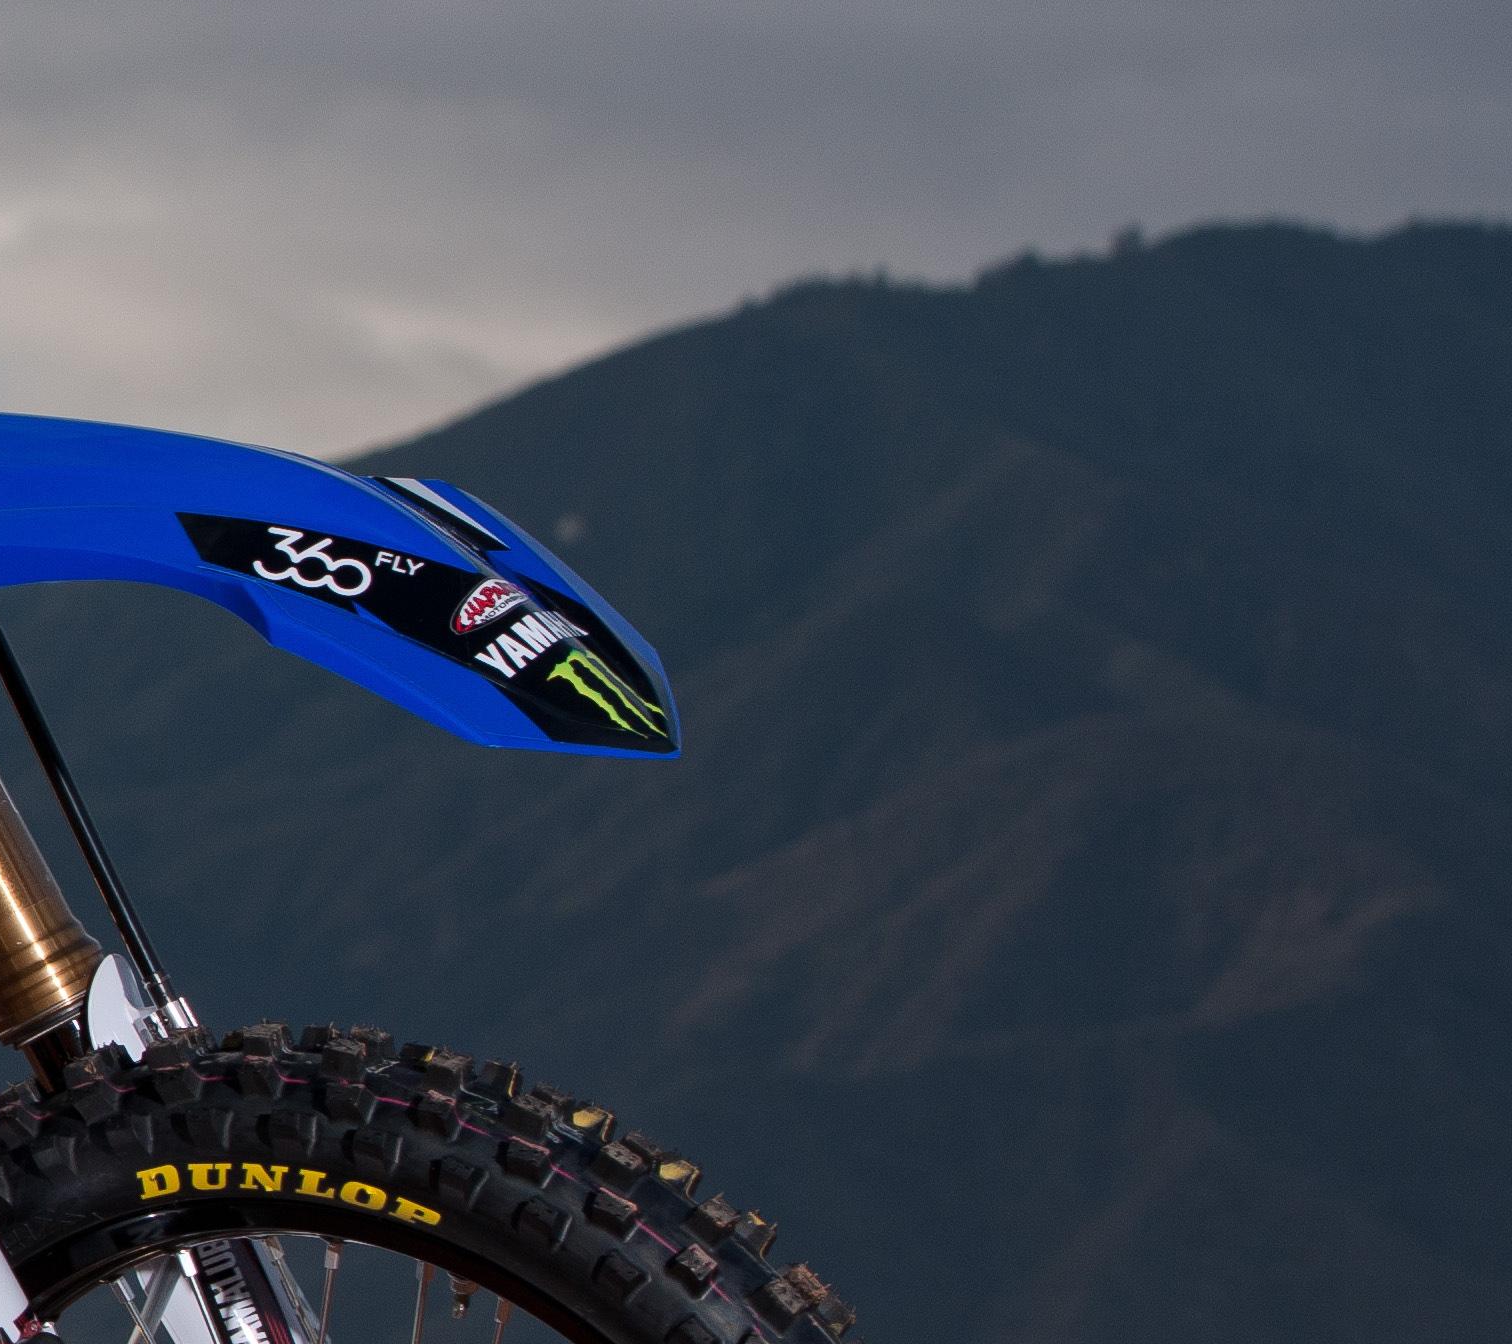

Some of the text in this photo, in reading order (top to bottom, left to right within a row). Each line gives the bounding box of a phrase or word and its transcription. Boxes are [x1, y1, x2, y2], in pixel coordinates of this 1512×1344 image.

[252, 525, 425, 596] 360 FLY
[474, 609, 590, 678] YAMAHA
[136, 1163, 443, 1226] DUNLOP
